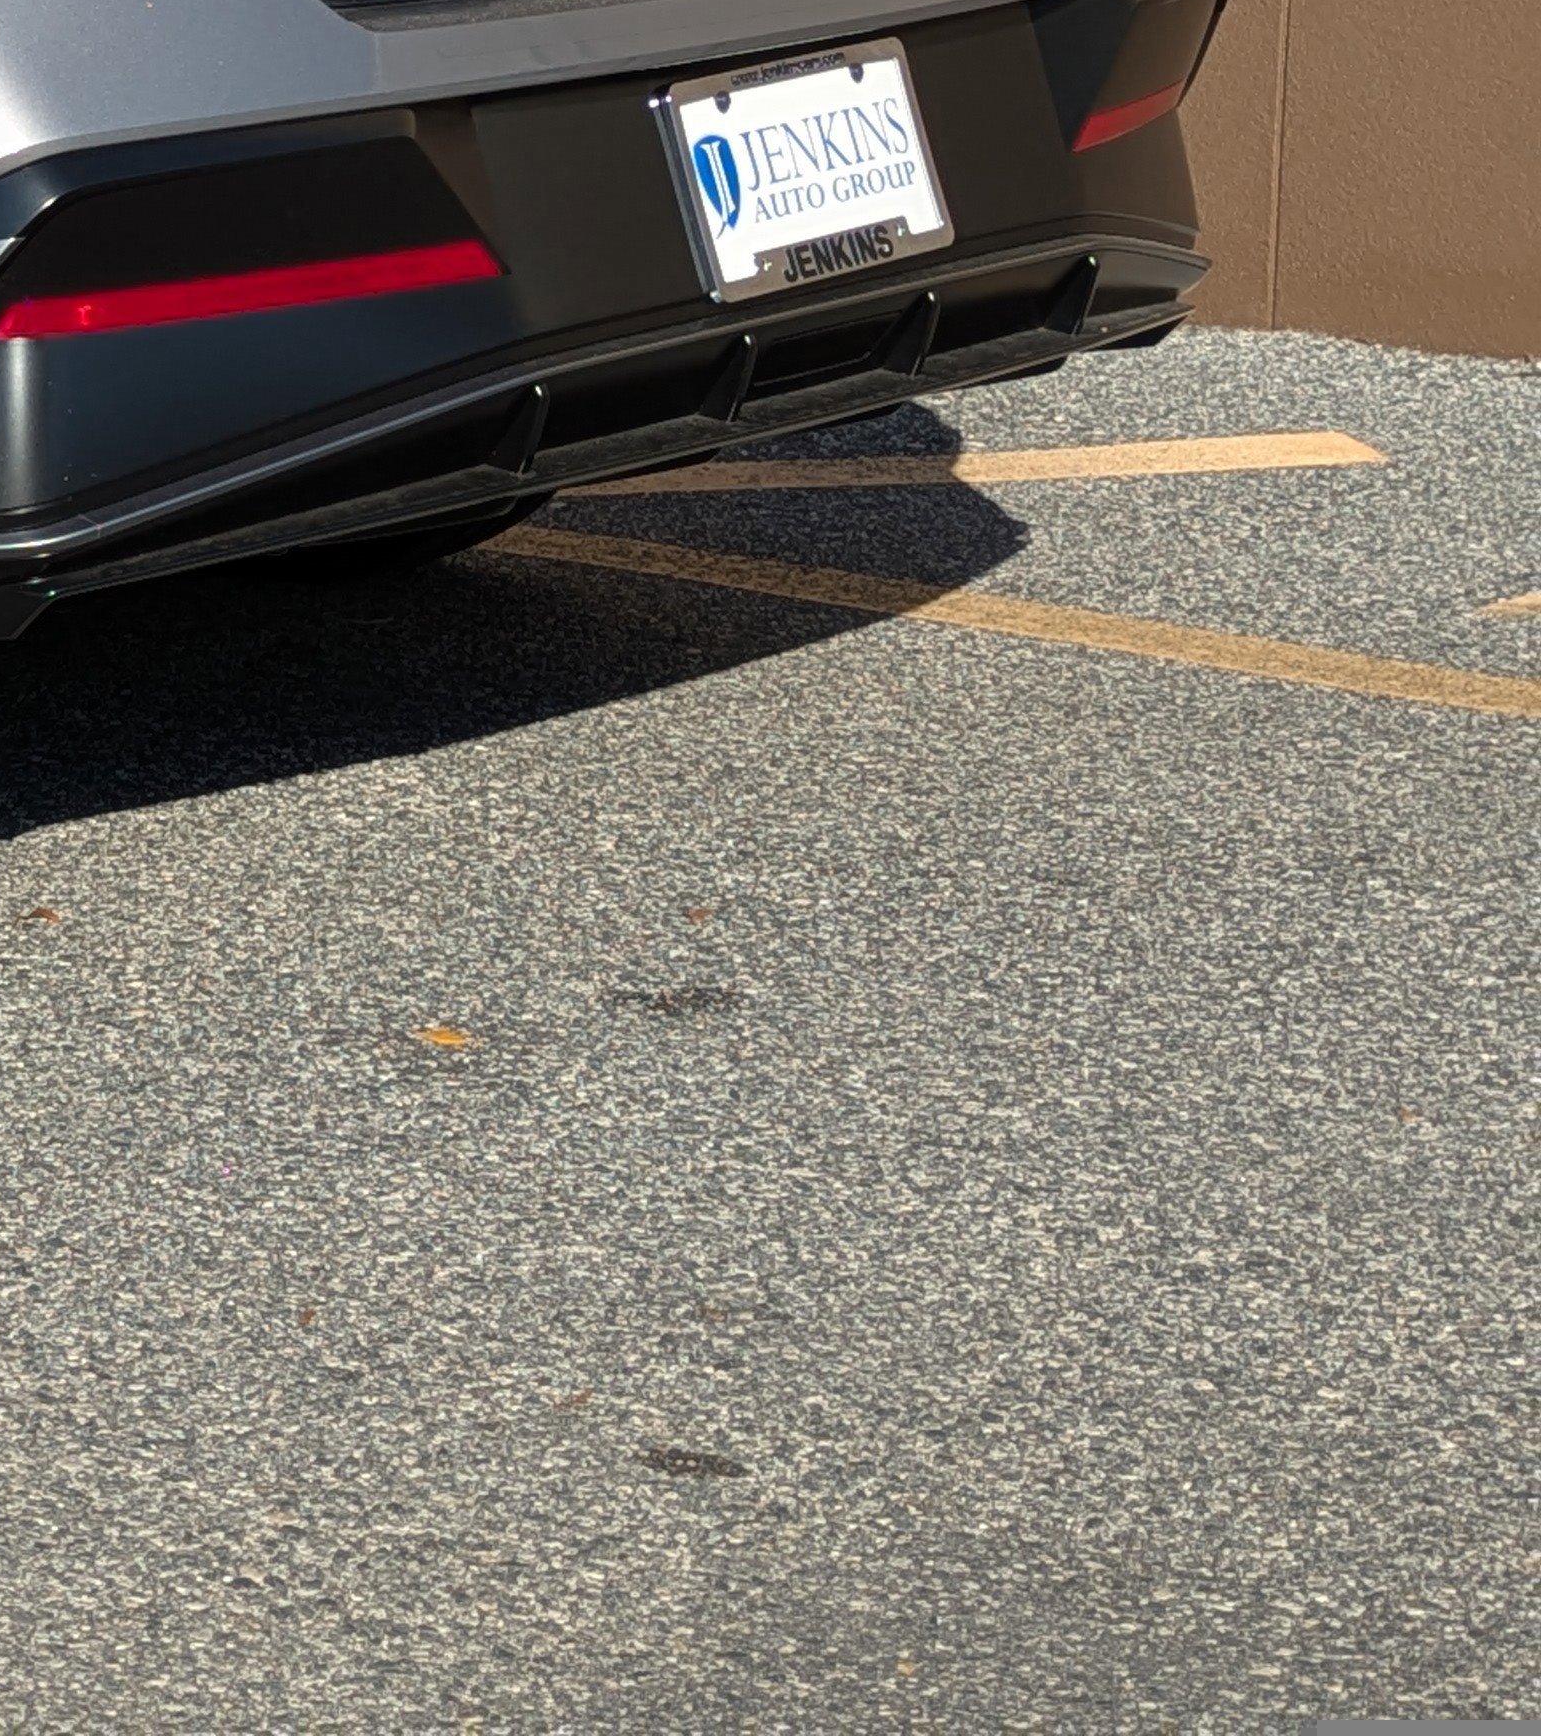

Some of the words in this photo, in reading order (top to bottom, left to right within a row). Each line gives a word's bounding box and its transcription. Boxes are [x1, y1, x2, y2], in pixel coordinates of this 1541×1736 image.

[739, 97, 910, 192] JENKINS
[754, 182, 826, 223] AUTO
[833, 160, 916, 202] GROUP
[783, 225, 894, 282] JENKINS
